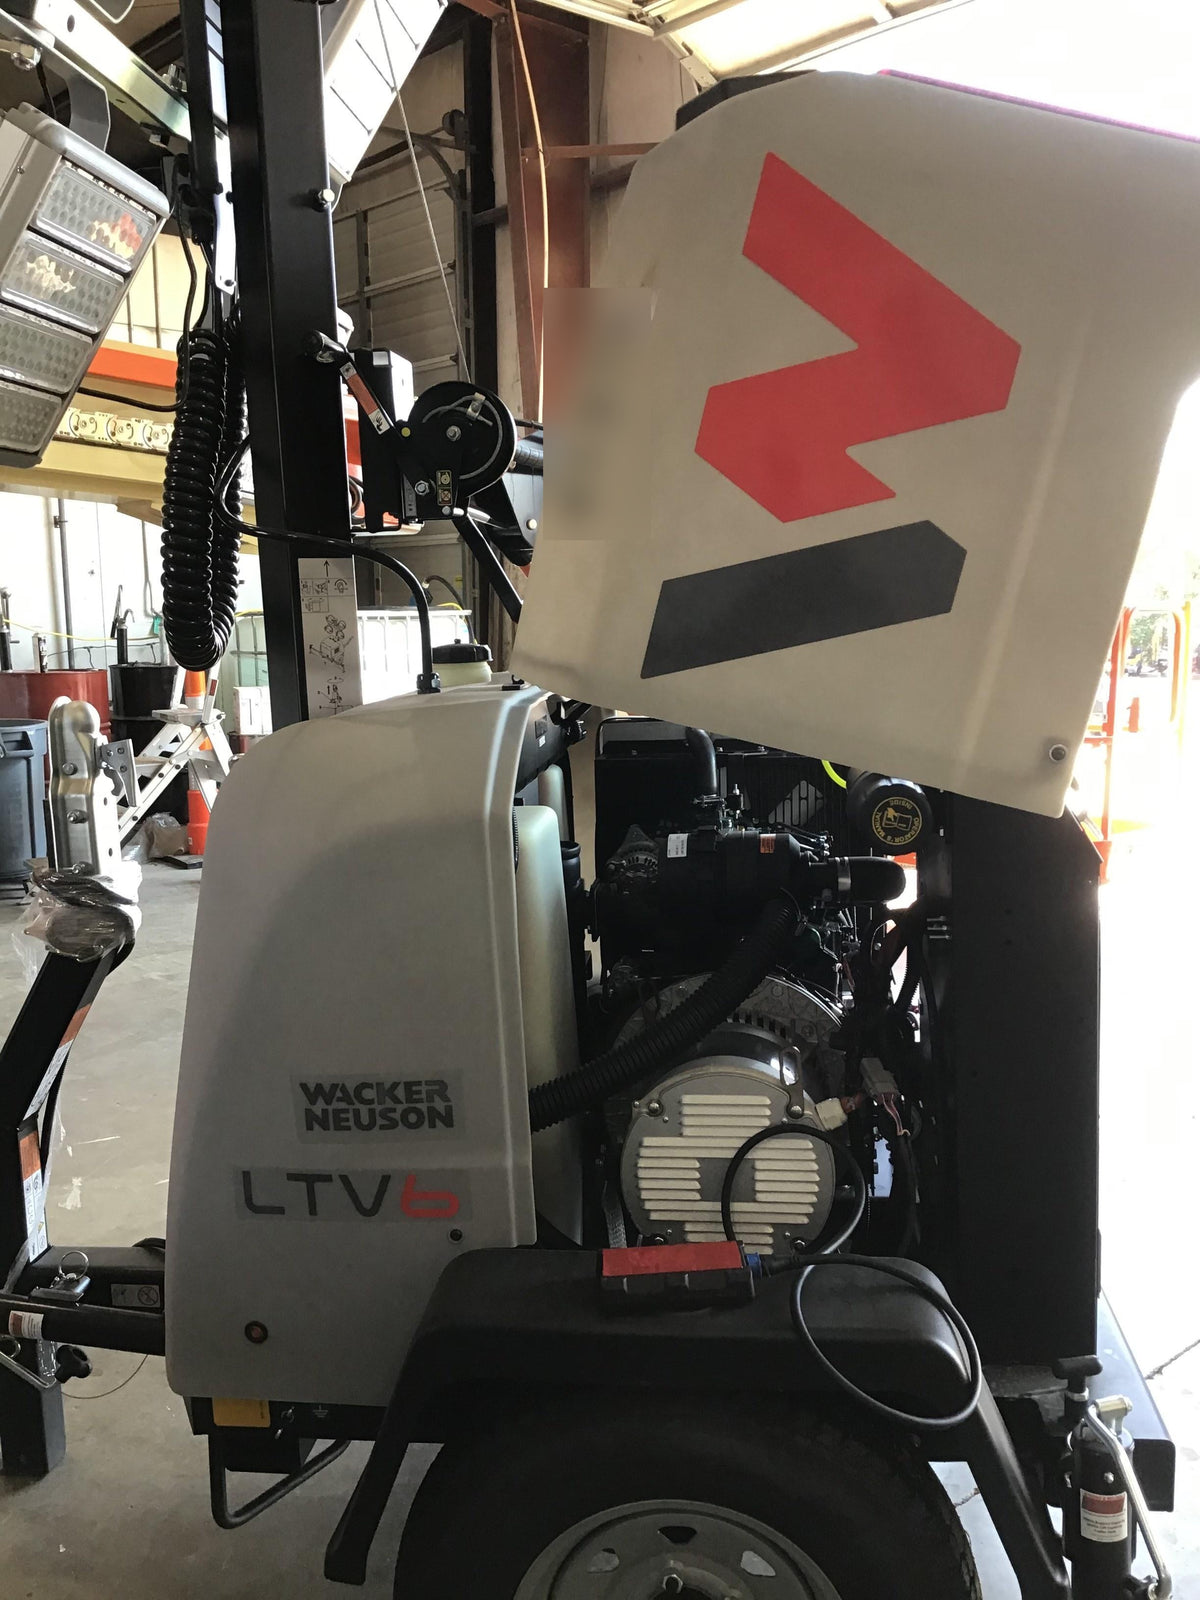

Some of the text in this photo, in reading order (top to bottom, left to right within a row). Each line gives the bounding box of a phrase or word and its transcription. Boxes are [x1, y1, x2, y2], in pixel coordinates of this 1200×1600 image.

[889, 799, 913, 810] INSIDE
[874, 811, 886, 837] MANUAL
[299, 1079, 453, 1106] WACKER
[304, 1104, 454, 1132] NEUSON
[241, 1170, 460, 1218] LTV6
